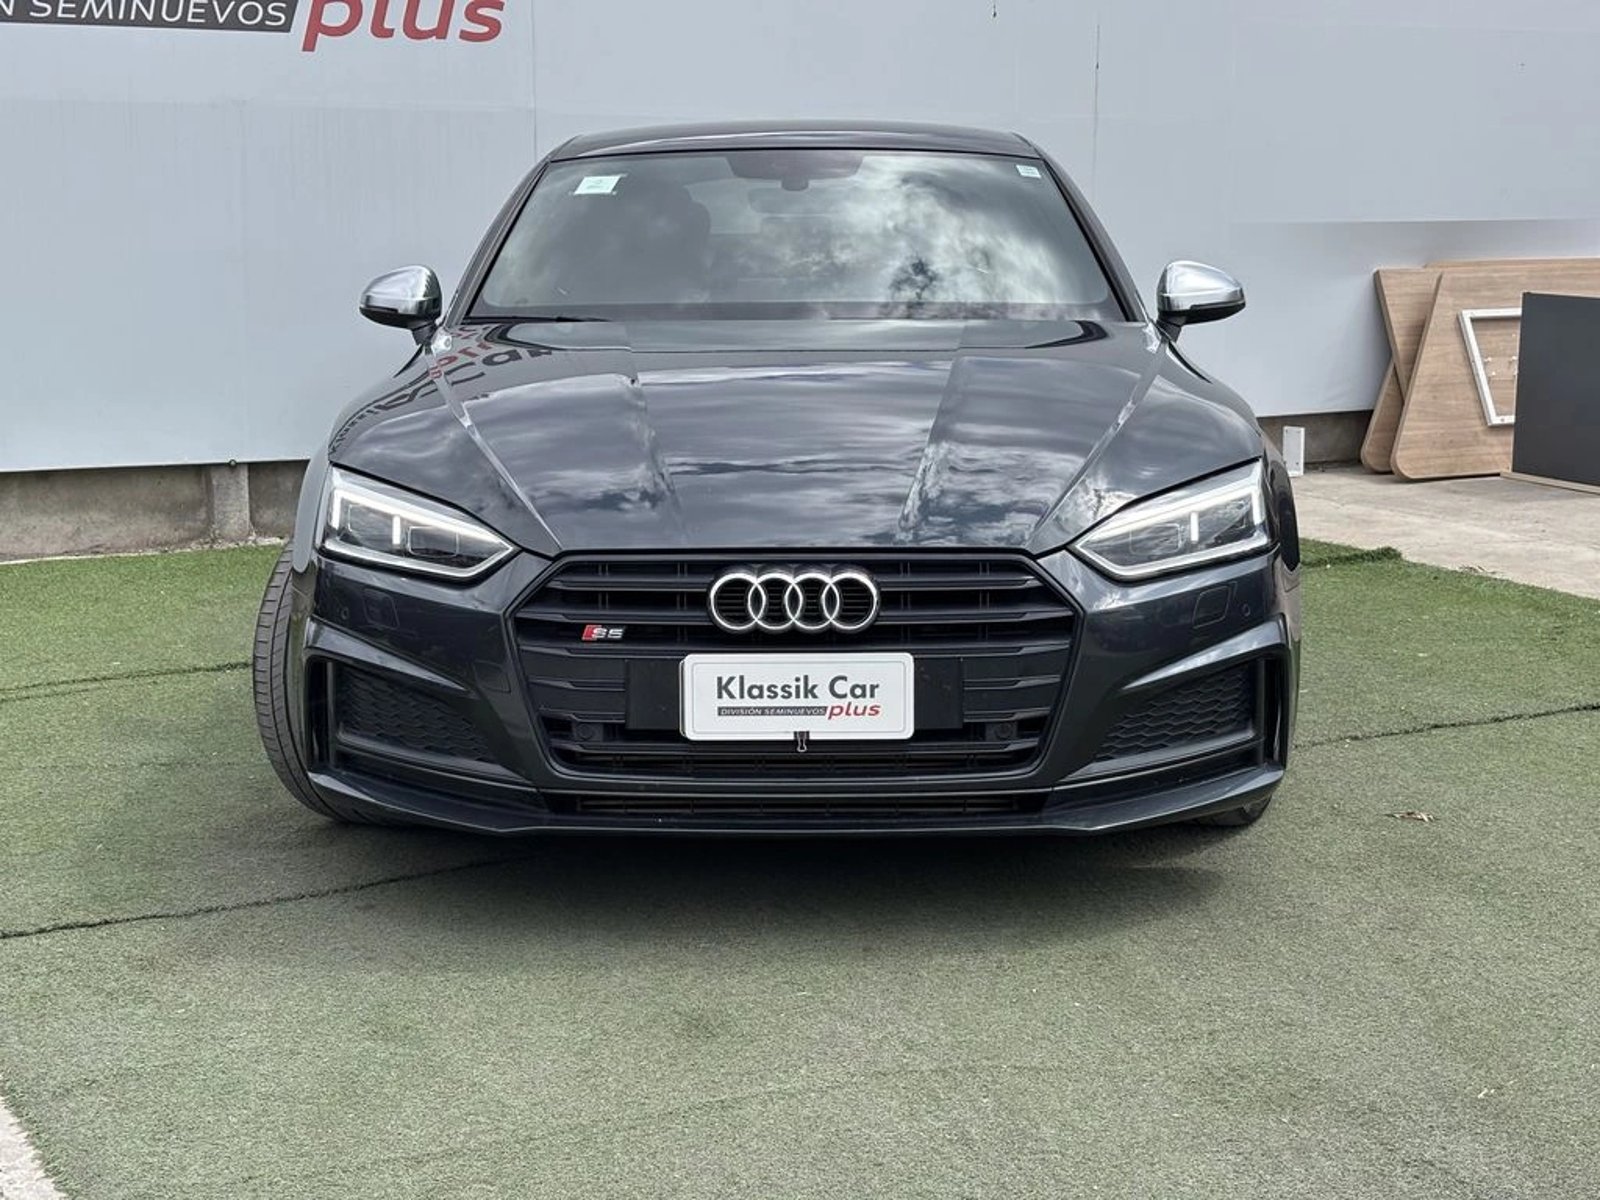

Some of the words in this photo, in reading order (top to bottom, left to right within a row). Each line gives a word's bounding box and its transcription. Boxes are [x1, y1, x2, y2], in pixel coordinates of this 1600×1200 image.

[29, 0, 287, 26] SEMINUEVOS
[301, 0, 505, 52] plus
[716, 675, 819, 699] Klassik
[828, 675, 880, 699] Car
[764, 707, 826, 716] SEMINUEVOS
[827, 701, 881, 720] plus
